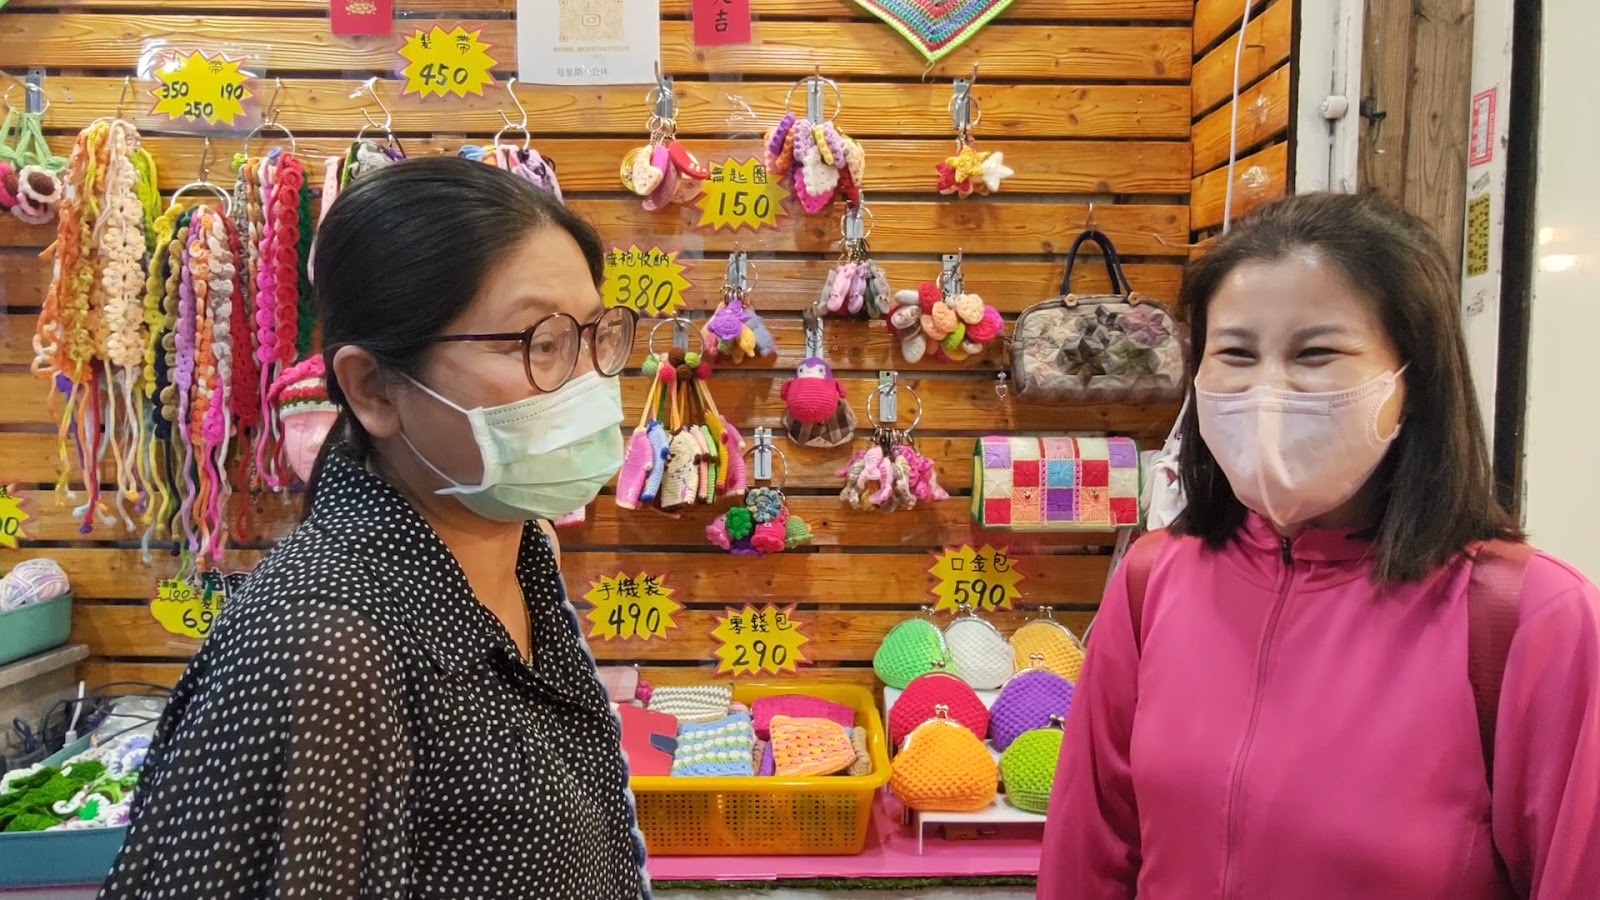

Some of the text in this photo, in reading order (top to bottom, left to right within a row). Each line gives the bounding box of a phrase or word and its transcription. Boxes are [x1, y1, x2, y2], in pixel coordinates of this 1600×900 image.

[419, 63, 469, 86] 450
[161, 81, 244, 100] 350 190
[184, 101, 213, 118] 250
[718, 191, 770, 218] 150
[616, 274, 674, 311] 380
[951, 552, 1009, 573] 口金包
[168, 590, 191, 600] 100
[597, 576, 664, 601] 手機袋
[954, 579, 1006, 607] 590
[608, 603, 661, 635] 490
[728, 612, 793, 635] 零錢包
[731, 640, 787, 667] 290
